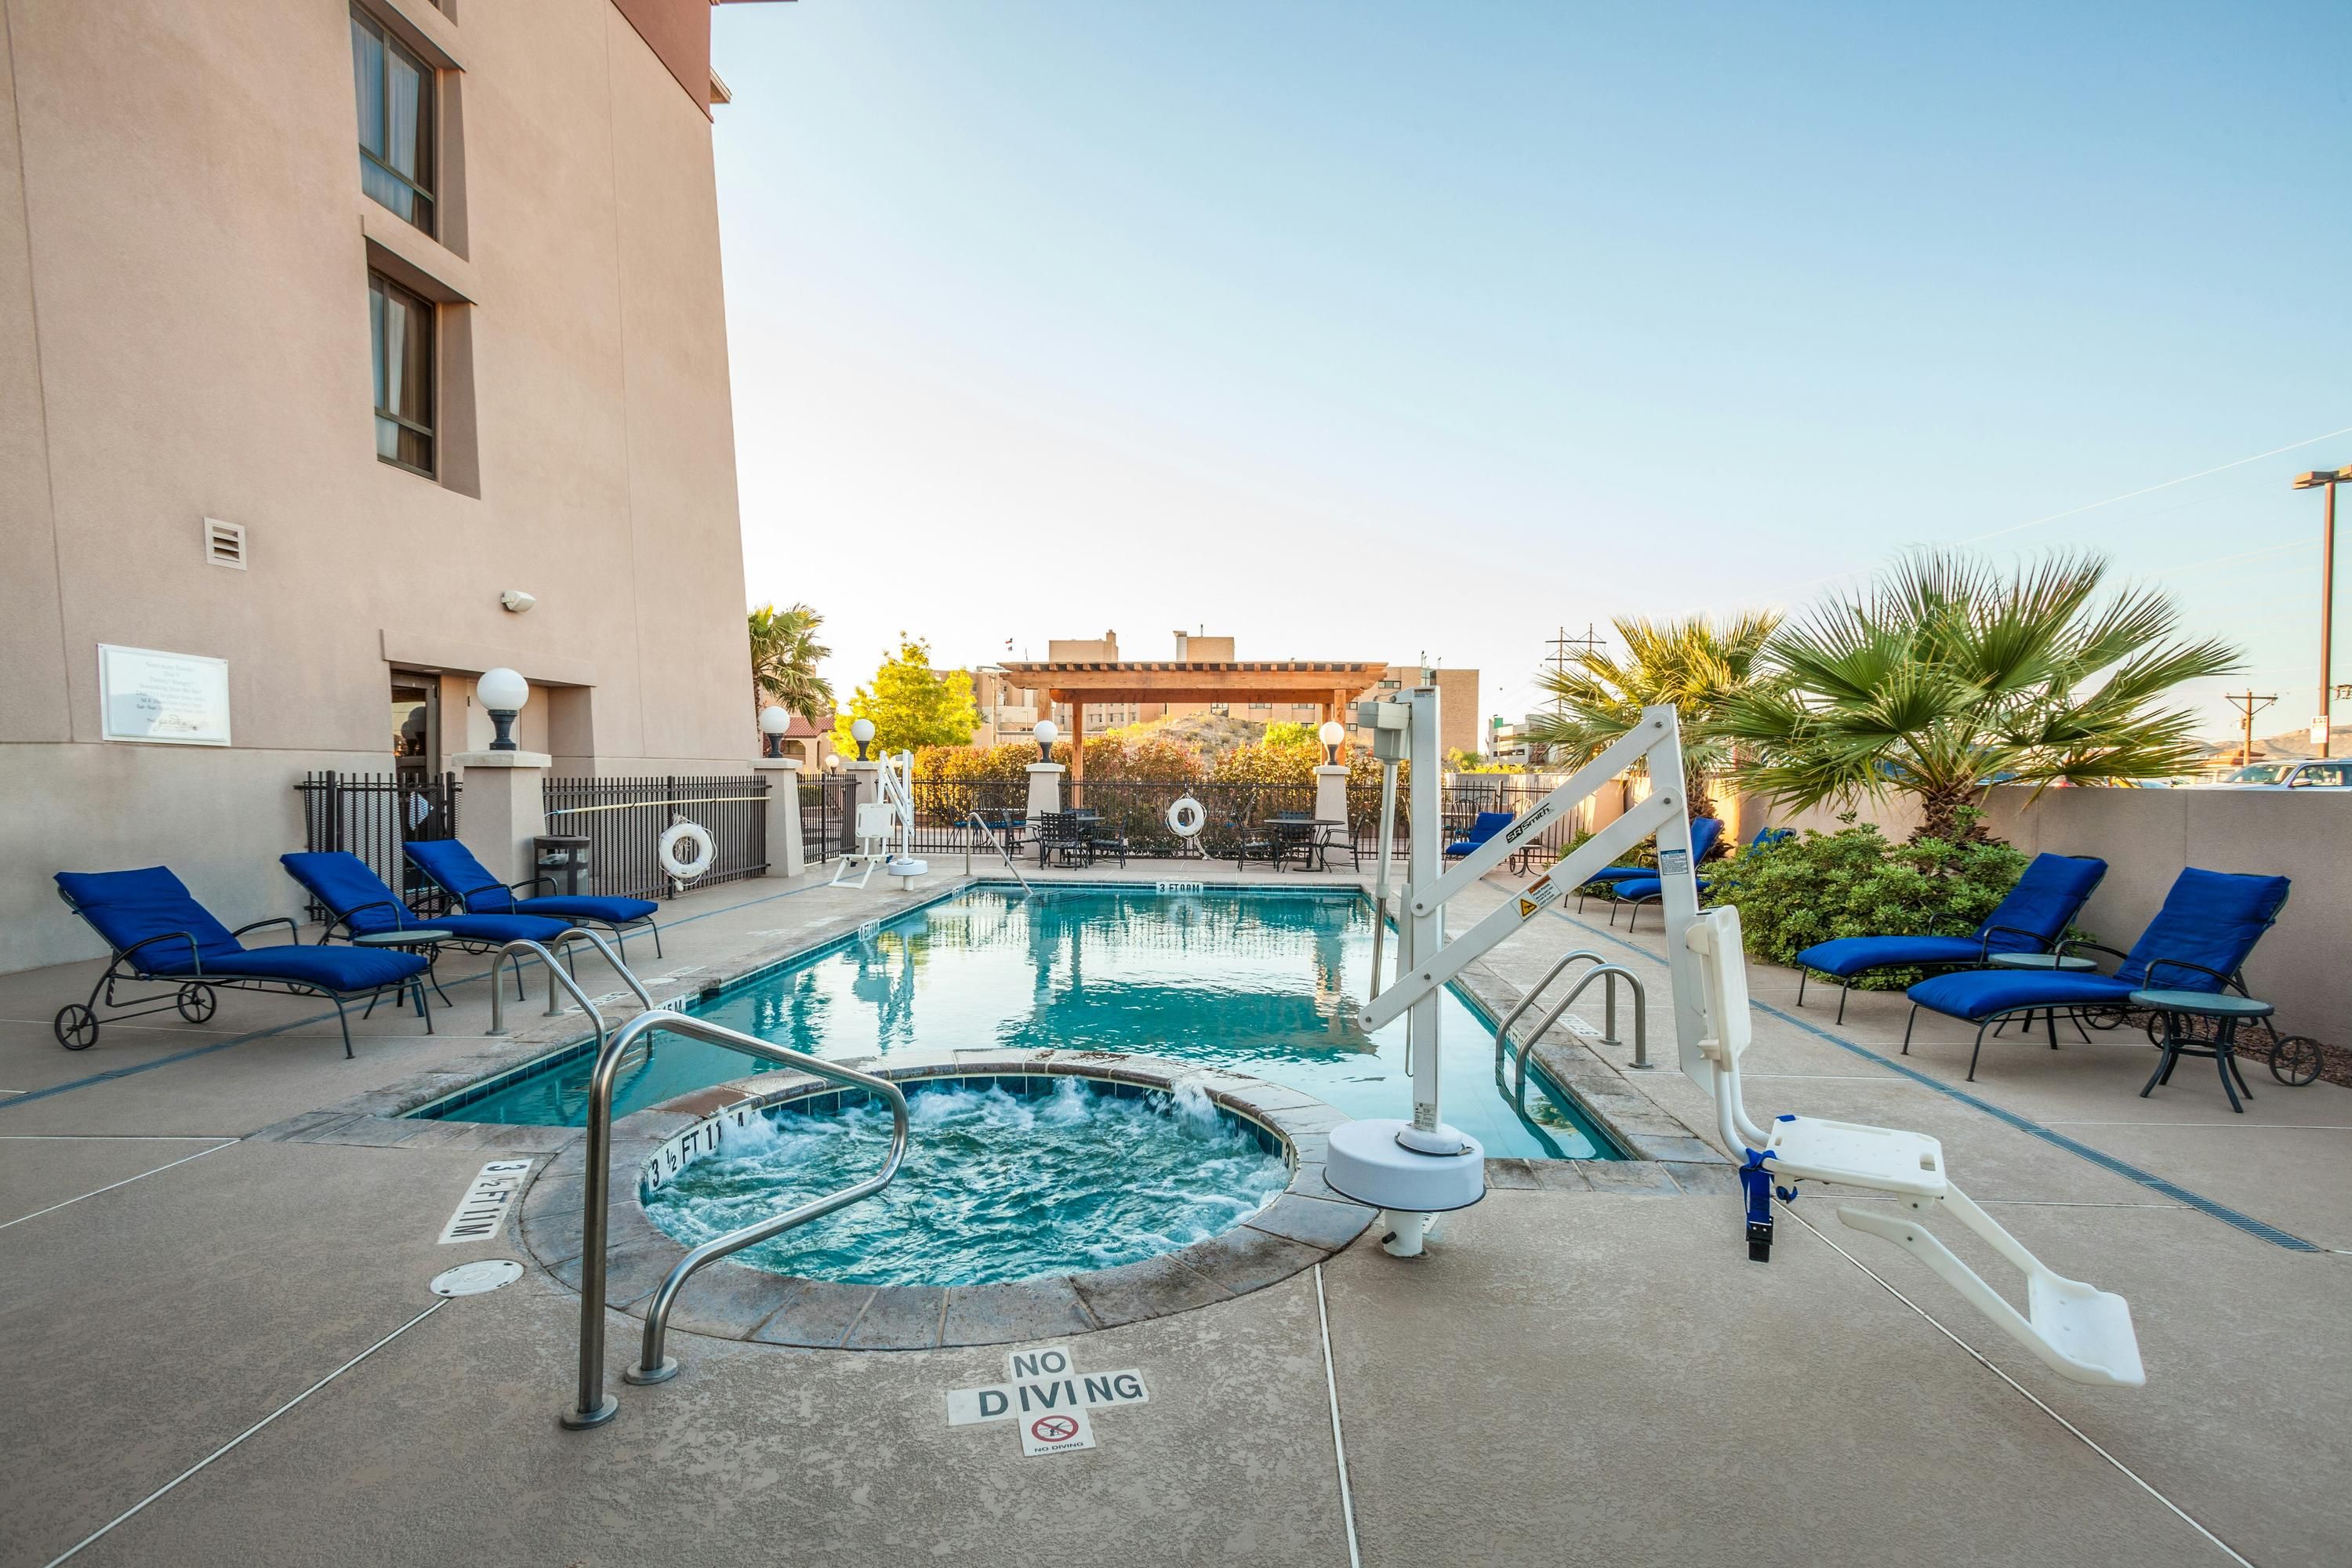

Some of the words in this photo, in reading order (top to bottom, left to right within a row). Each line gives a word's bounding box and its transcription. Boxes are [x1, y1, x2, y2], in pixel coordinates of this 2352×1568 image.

[652, 1159, 660, 1188] 3
[681, 1129, 699, 1164] FT
[470, 1191, 510, 1203] FT
[1013, 1351, 1066, 1377] NO
[978, 1374, 1143, 1417] DIVING
[1051, 1441, 1083, 1450] DIVING
